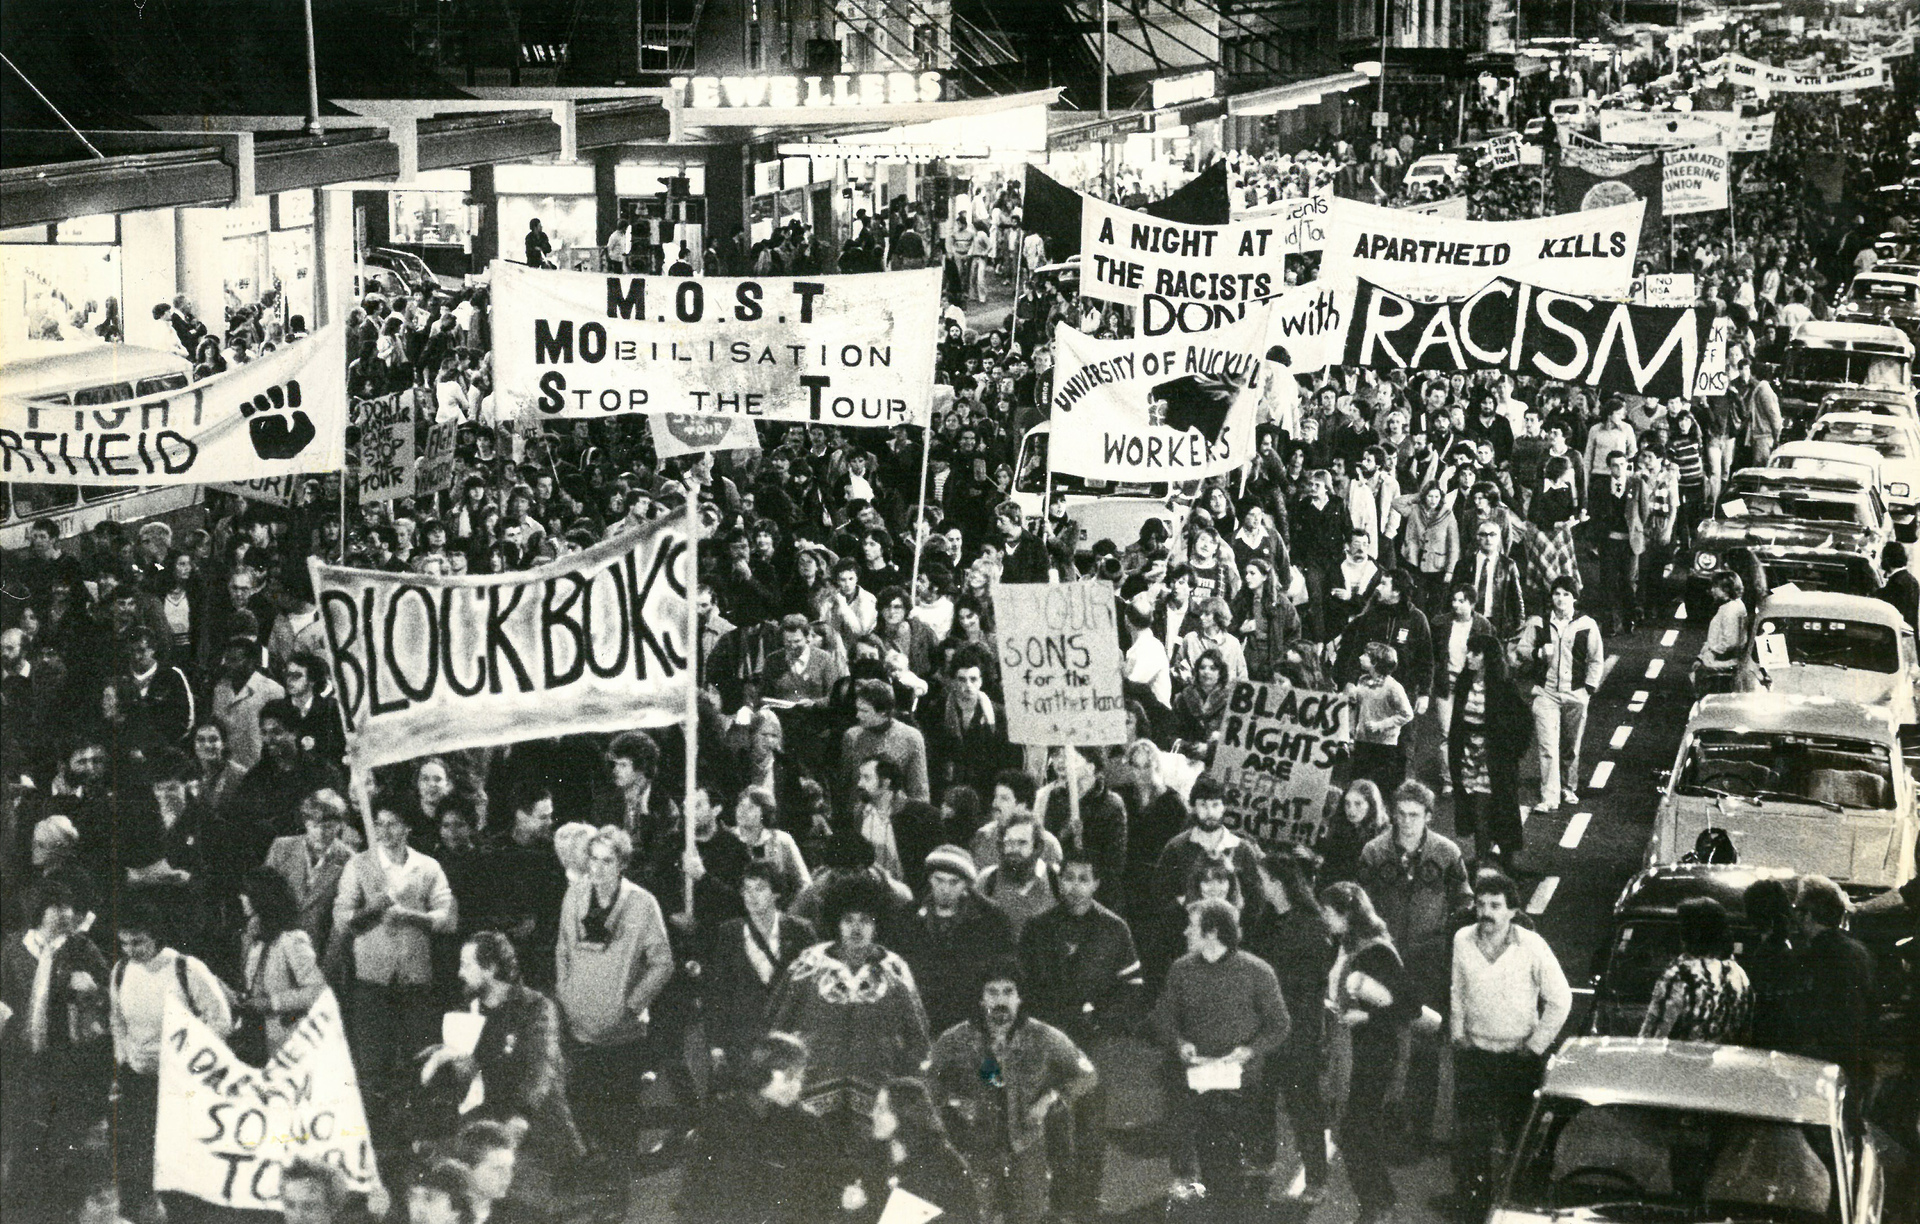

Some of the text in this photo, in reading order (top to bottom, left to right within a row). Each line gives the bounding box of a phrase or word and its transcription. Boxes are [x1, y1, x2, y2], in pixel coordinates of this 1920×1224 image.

[1766, 72, 1787, 83] PLAY
[1794, 76, 1821, 85] WITH
[1827, 66, 1875, 84] APARTHEID
[1492, 136, 1517, 148] STOP
[1494, 153, 1517, 165] TOUR
[1495, 146, 1511, 154] THE
[1665, 178, 1702, 193] UNION
[1098, 217, 1273, 258] A NIGHT AT
[1353, 230, 1627, 267] APARTHEID KILLS
[1093, 254, 1272, 301] THE RACISTS
[1649, 286, 1670, 295] VISA
[1655, 277, 1673, 286] NO
[1281, 289, 1341, 338] with
[535, 318, 891, 367] MOBILISATION
[1360, 278, 1698, 400] RACISM
[538, 370, 908, 422] STOP THE TOUR
[1053, 351, 1135, 412] UNIVERSITY
[1142, 350, 1176, 376] OF
[683, 421, 723, 436] TOUR
[1104, 425, 1231, 468] WORKERS
[363, 439, 405, 464] STOP
[360, 466, 405, 493] TOUR
[320, 585, 535, 732] BLOCK
[1004, 633, 1091, 670] SONS
[1022, 668, 1091, 688] for the
[1224, 714, 1338, 770] RIGHTS
[1241, 752, 1294, 782] ARE
[198, 1102, 267, 1151] SO
